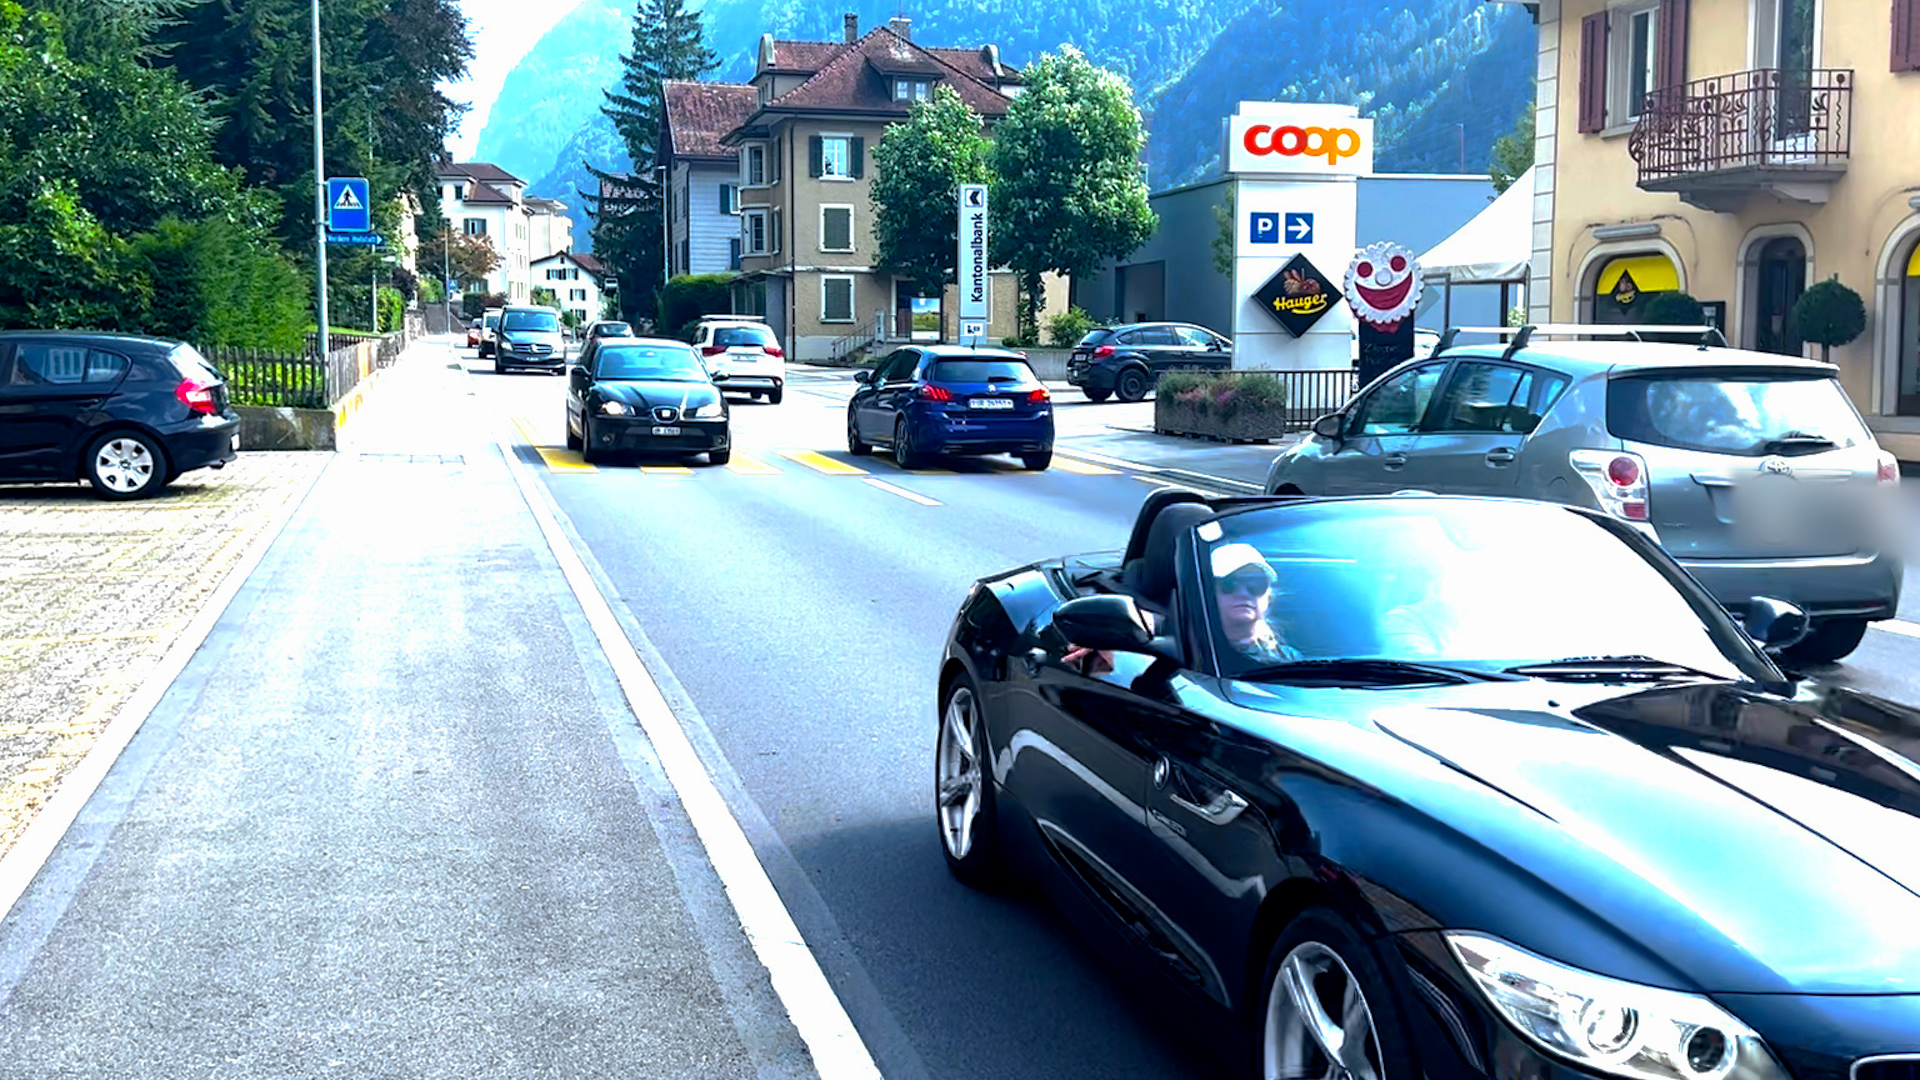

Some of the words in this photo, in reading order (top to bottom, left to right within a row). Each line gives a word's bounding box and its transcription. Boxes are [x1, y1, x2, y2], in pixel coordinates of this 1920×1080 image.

[1243, 124, 1361, 166] coop
[1257, 217, 1274, 238] P
[971, 212, 983, 303] Kantonalbank
[1273, 293, 1328, 312] Hauger
